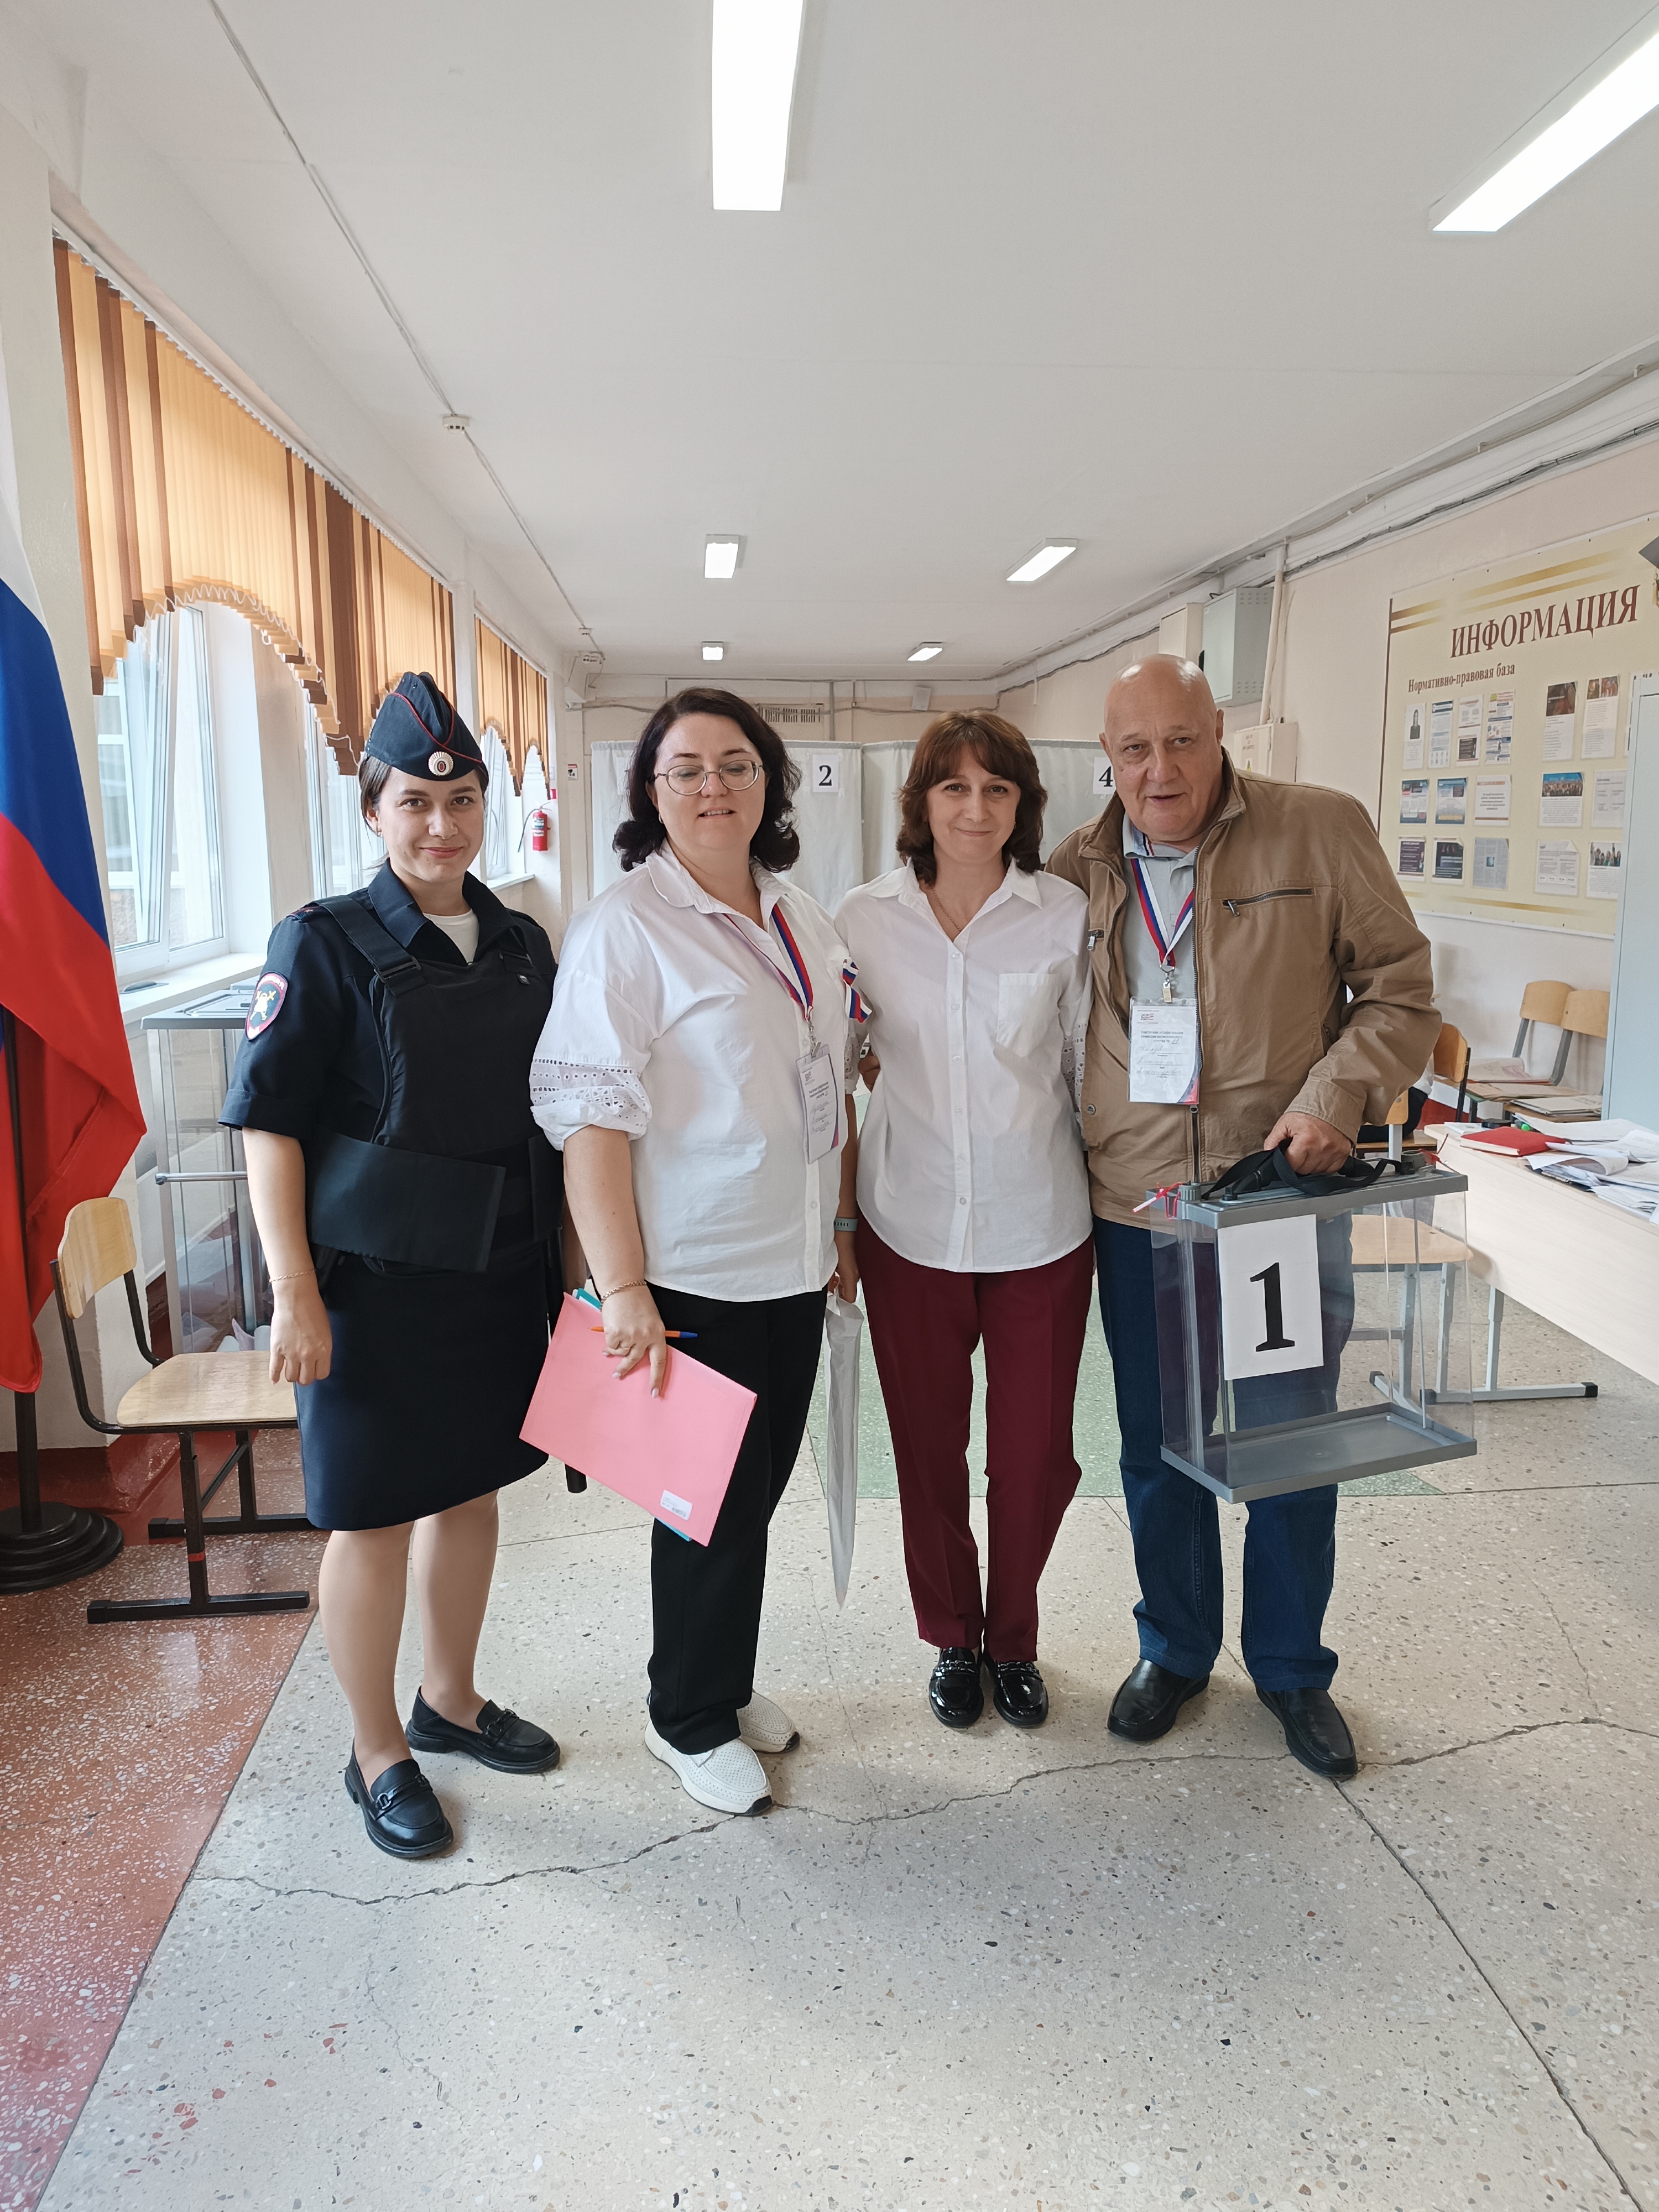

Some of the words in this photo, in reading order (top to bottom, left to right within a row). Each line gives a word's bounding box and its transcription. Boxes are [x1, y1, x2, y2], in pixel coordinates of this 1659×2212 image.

[1450, 585, 1640, 658] ИНФОРМАЦИЯ
[1408, 668, 1494, 695] Нормативно-правовая
[1496, 662, 1515, 677] база
[818, 765, 832, 786] 2
[1098, 766, 1114, 787] 4
[1250, 1261, 1295, 1352] 1
